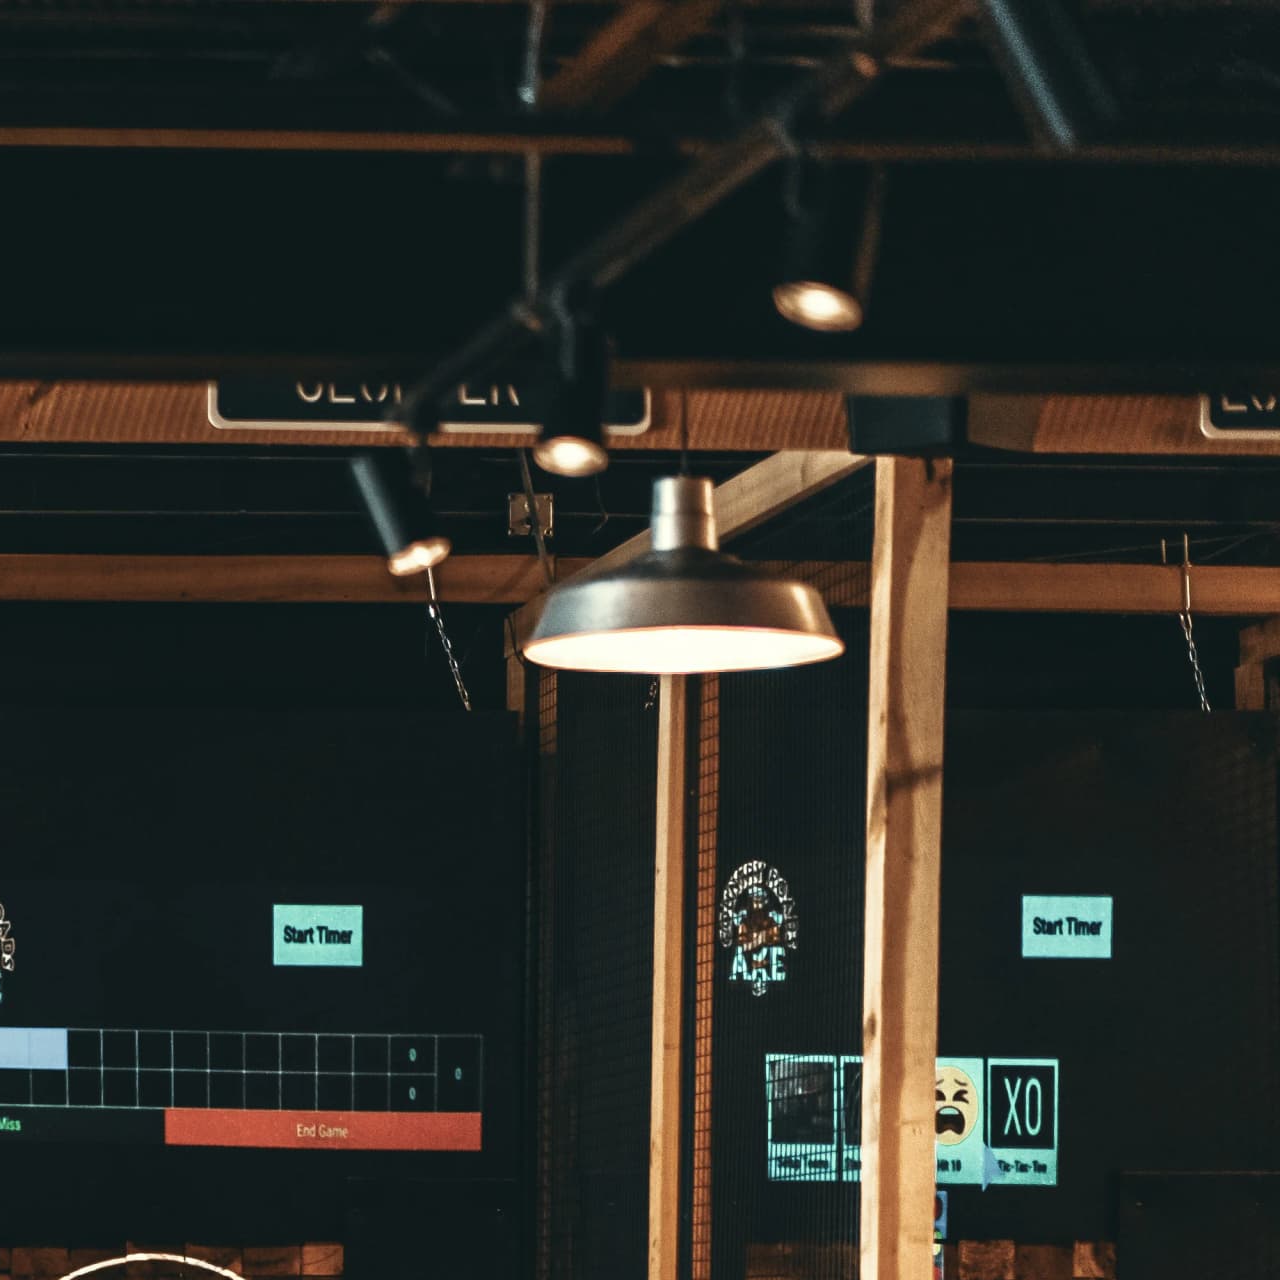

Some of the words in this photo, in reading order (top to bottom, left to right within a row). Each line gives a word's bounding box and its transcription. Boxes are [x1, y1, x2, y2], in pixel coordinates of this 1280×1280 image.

[1033, 916, 1063, 935] Start
[1065, 917, 1102, 936] Timer
[284, 925, 314, 944] Start
[316, 925, 353, 944] Timer
[409, 1048, 416, 1061] 0
[455, 1067, 462, 1080] 0
[409, 1087, 416, 1100] 0
[1004, 1077, 1042, 1136] XO
[297, 1124, 316, 1137] End
[318, 1124, 348, 1138] Game
